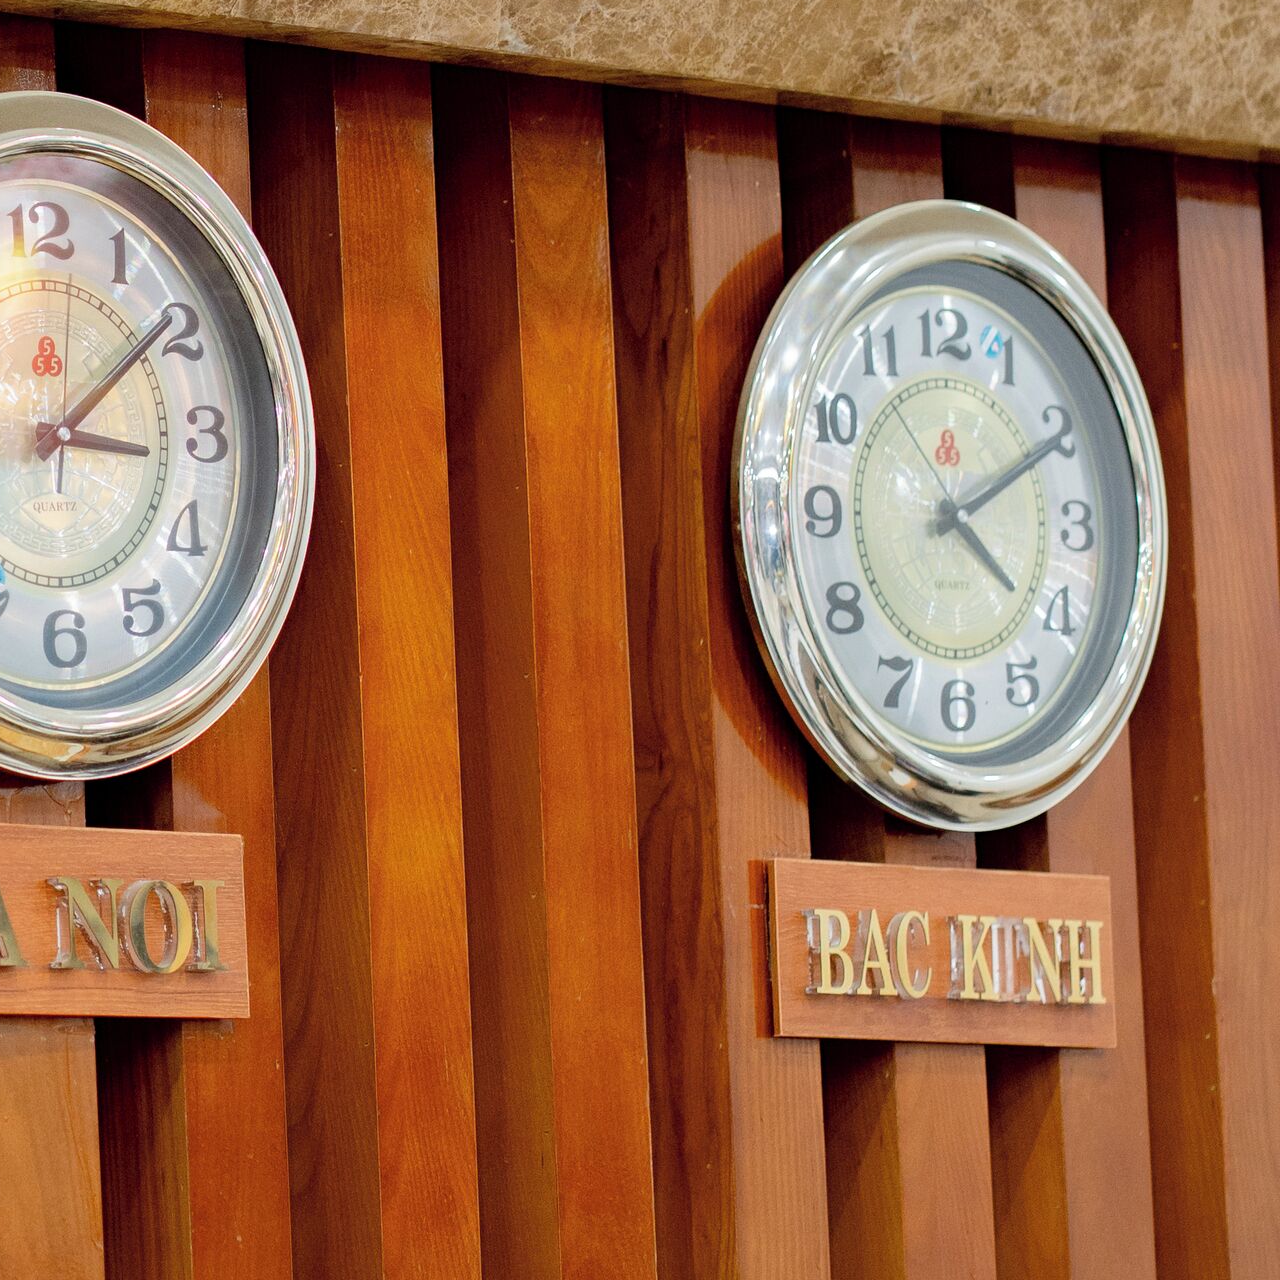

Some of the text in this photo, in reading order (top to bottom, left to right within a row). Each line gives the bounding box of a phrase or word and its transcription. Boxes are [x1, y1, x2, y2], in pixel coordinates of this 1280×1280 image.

[7, 201, 74, 261] 12
[108, 227, 130, 285] 1
[160, 302, 204, 362] 2
[860, 324, 899, 378] 11
[919, 308, 972, 361] 12
[1002, 334, 1016, 386] 1
[185, 405, 229, 464] 3
[815, 392, 858, 446] 10
[1042, 404, 1076, 458] 2
[32, 501, 78, 514] QUARTZ
[166, 499, 208, 558] 4
[804, 485, 842, 538] 9
[1061, 500, 1094, 552] 3
[122, 579, 165, 638] 5
[826, 582, 865, 635] 8
[1042, 584, 1075, 636] 4
[42, 609, 87, 668] 6
[876, 655, 914, 709] 7
[940, 679, 976, 732] 6
[1006, 654, 1040, 707] 5
[46, 876, 230, 975] NOI
[801, 907, 933, 1000] BAC
